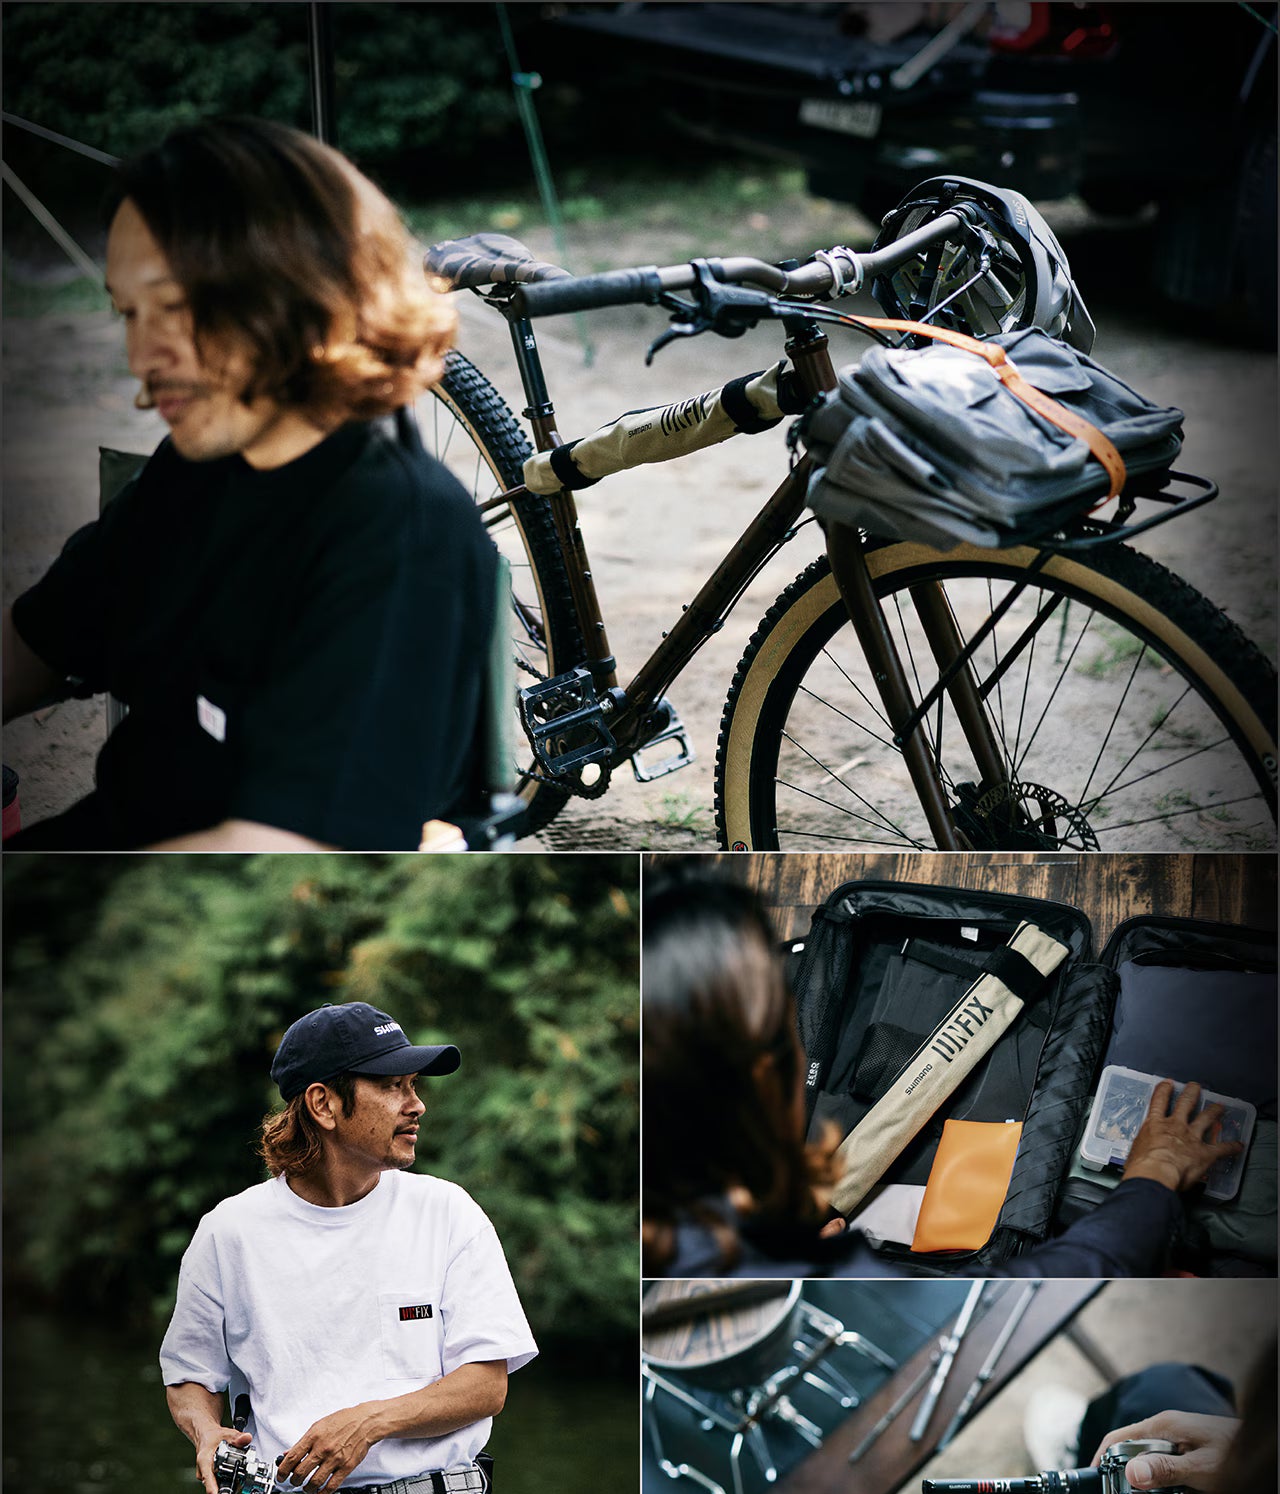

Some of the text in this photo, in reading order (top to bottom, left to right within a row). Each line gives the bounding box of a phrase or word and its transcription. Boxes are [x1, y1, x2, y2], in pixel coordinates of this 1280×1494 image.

[1012, 199, 1027, 227] SMITH
[628, 422, 652, 438] SHIMANO
[905, 996, 994, 1095] SHIMANO UNFIX
[977, 1479, 1012, 1494] UNFIX
